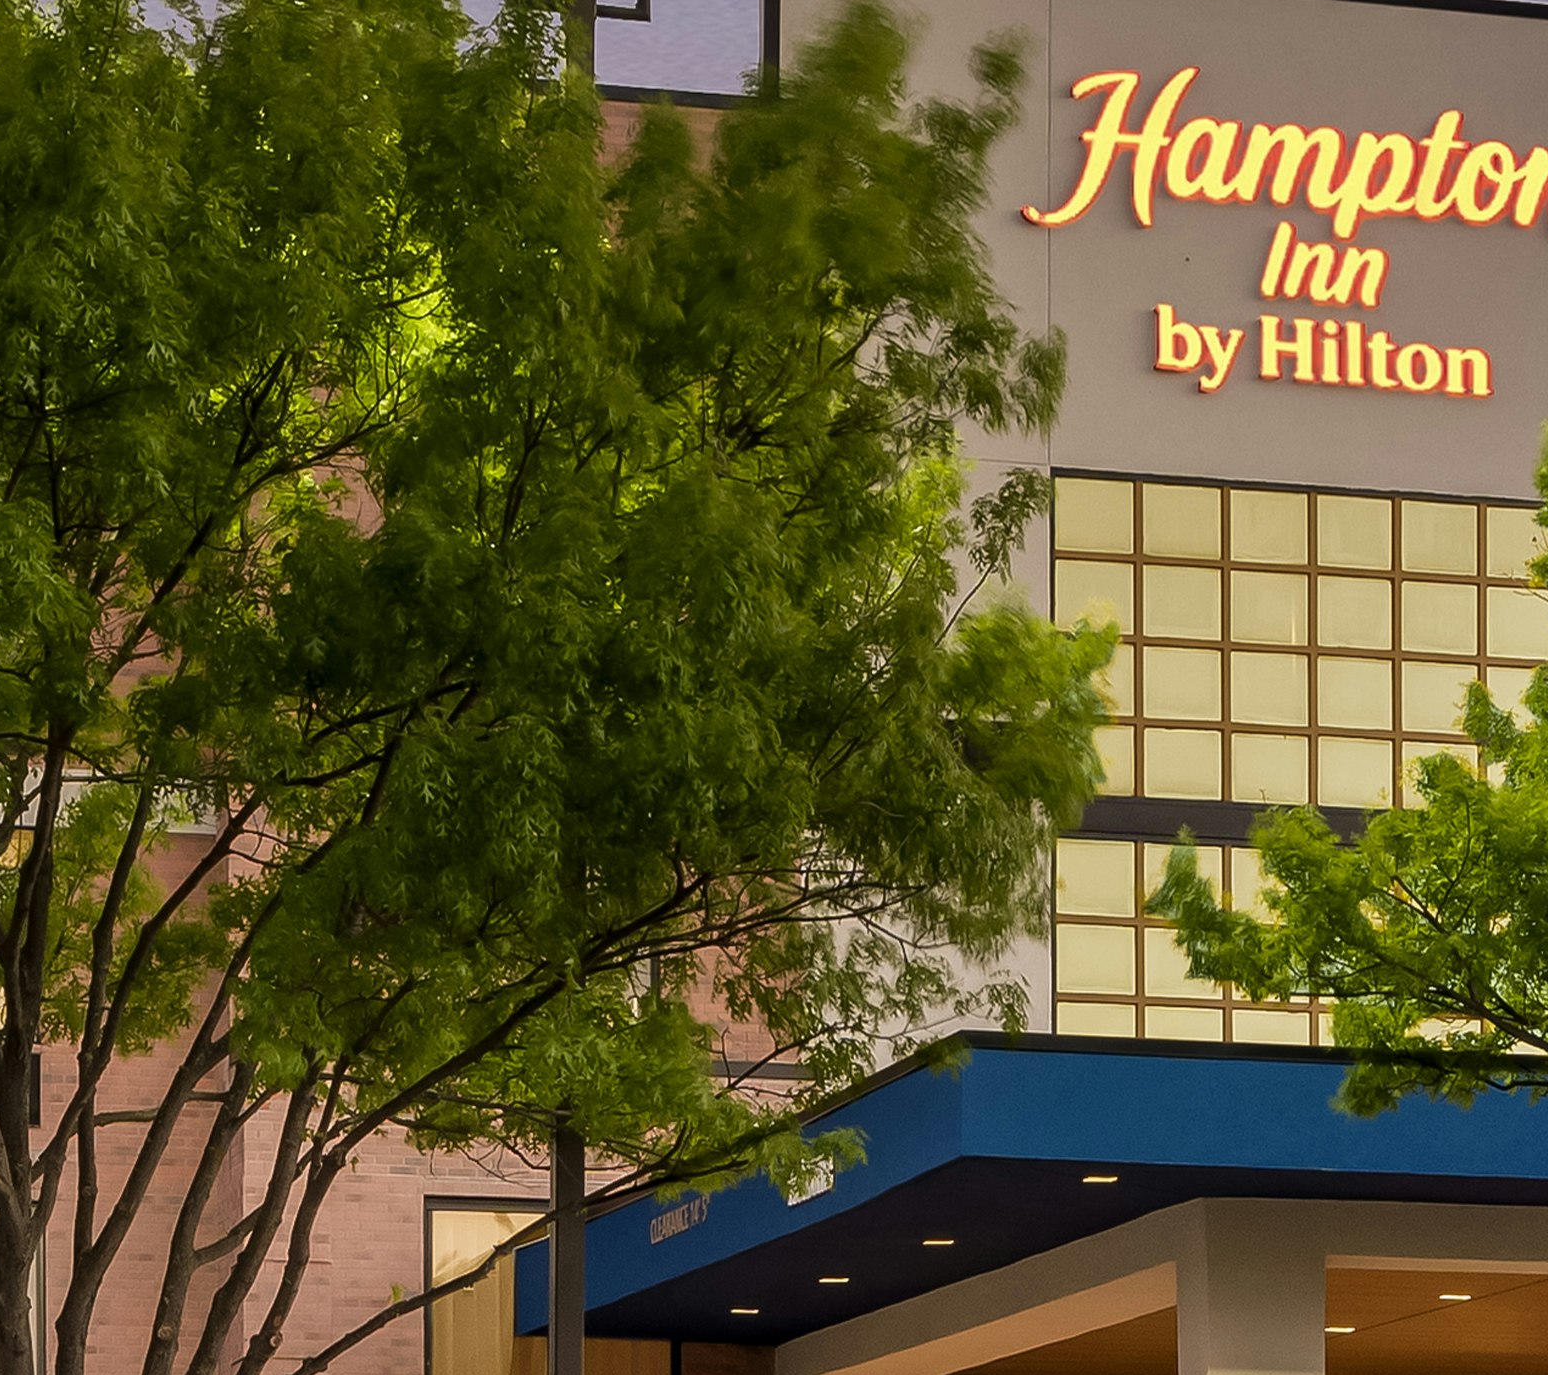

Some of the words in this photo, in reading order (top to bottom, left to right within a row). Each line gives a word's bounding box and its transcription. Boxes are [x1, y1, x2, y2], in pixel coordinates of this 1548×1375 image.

[1260, 221, 1391, 308] Inn
[1153, 303, 1246, 393] by
[1259, 313, 1494, 398] Hilton
